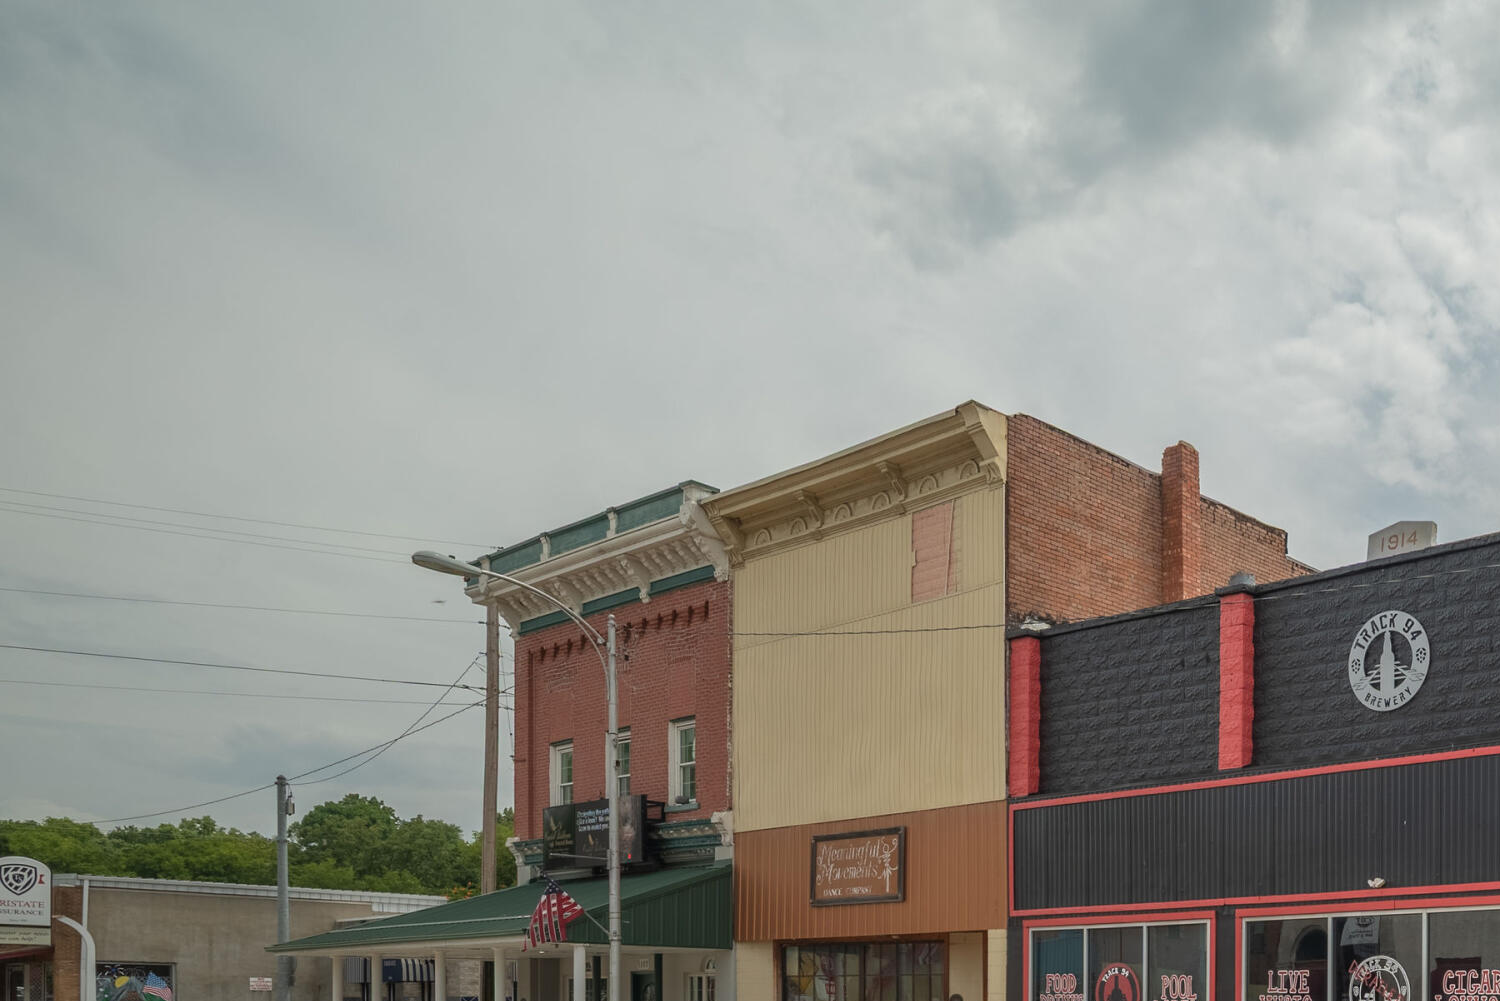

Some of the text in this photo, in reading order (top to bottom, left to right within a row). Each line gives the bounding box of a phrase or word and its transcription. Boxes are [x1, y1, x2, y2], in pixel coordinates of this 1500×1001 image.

[1381, 530, 1418, 552] 1914
[1354, 613, 1422, 650] TRACK 94
[1364, 686, 1412, 708] BREWERY
[817, 840, 880, 866] Meaningful
[816, 861, 879, 885] Movements
[1045, 973, 1076, 994] FOOD
[1160, 974, 1197, 1000] POOL
[1267, 970, 1310, 993] LIVE
